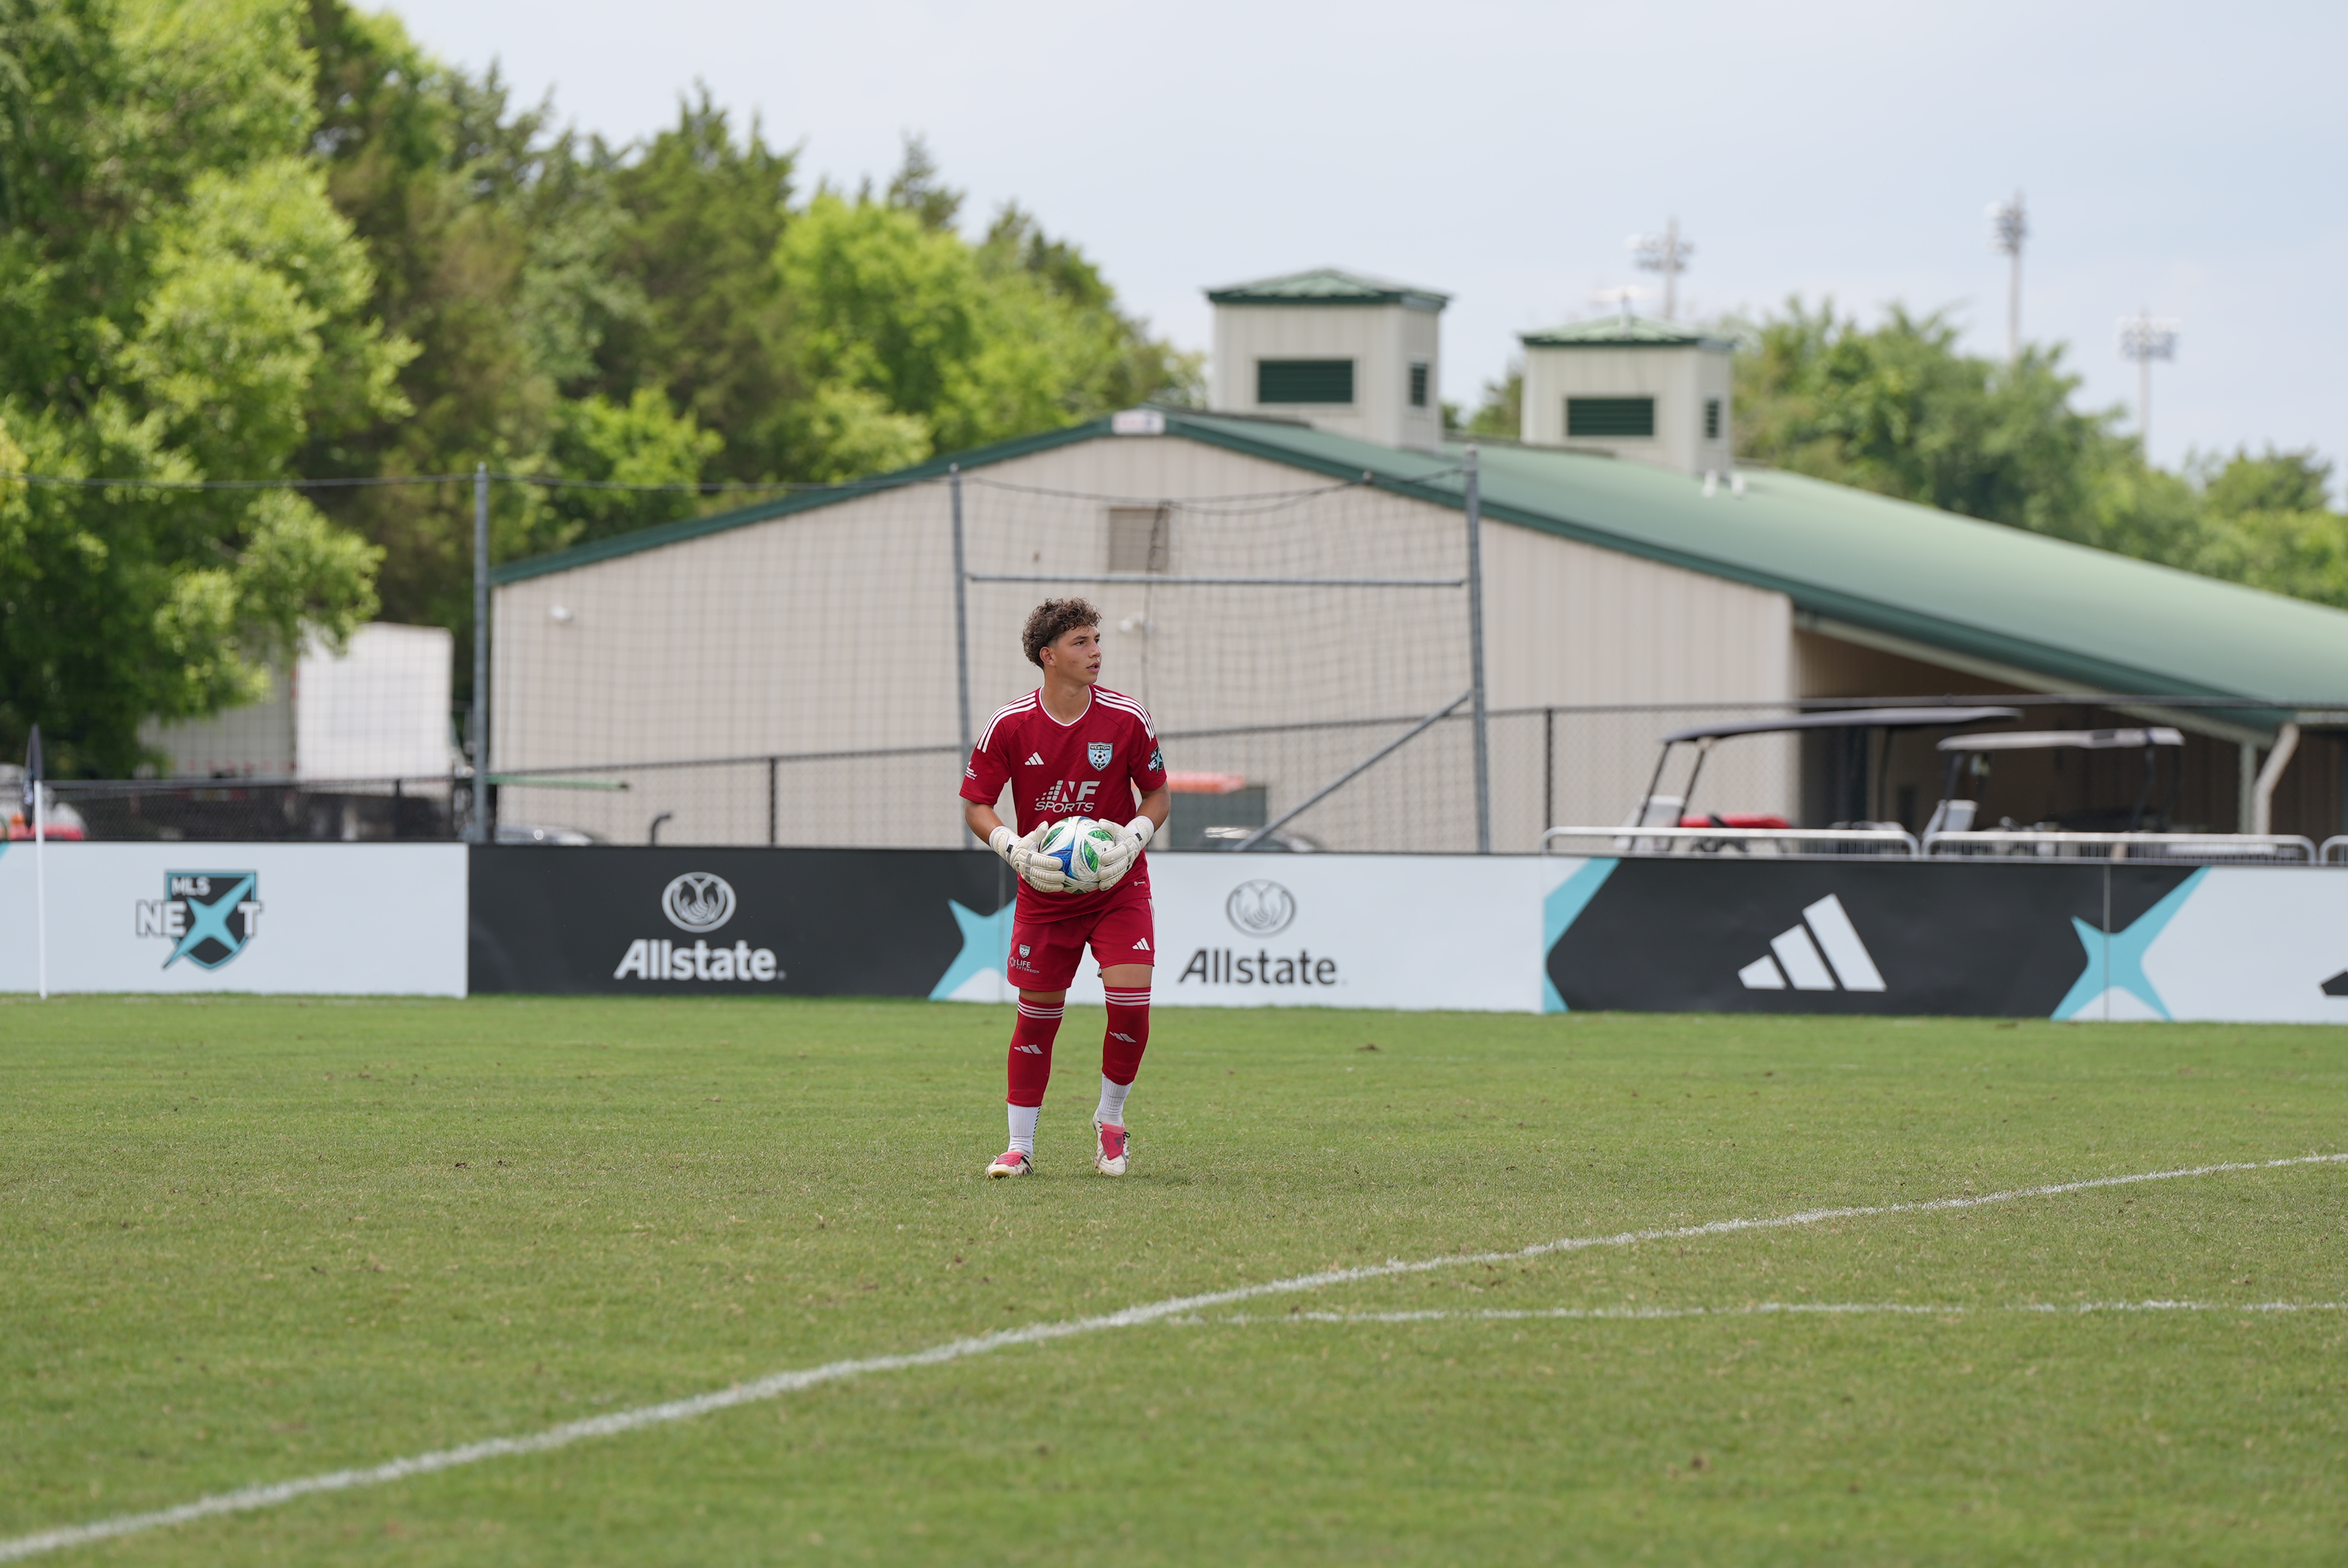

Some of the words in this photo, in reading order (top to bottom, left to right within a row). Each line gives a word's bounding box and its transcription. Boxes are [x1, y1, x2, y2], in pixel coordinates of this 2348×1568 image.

[1034, 801, 1095, 813] SPORTS
[171, 876, 211, 896] MLS
[612, 938, 777, 981] Allstate
[1016, 959, 1031, 968] LIFE
[1177, 947, 1337, 986] Allstate
[1016, 965, 1040, 974] EXTENSION
